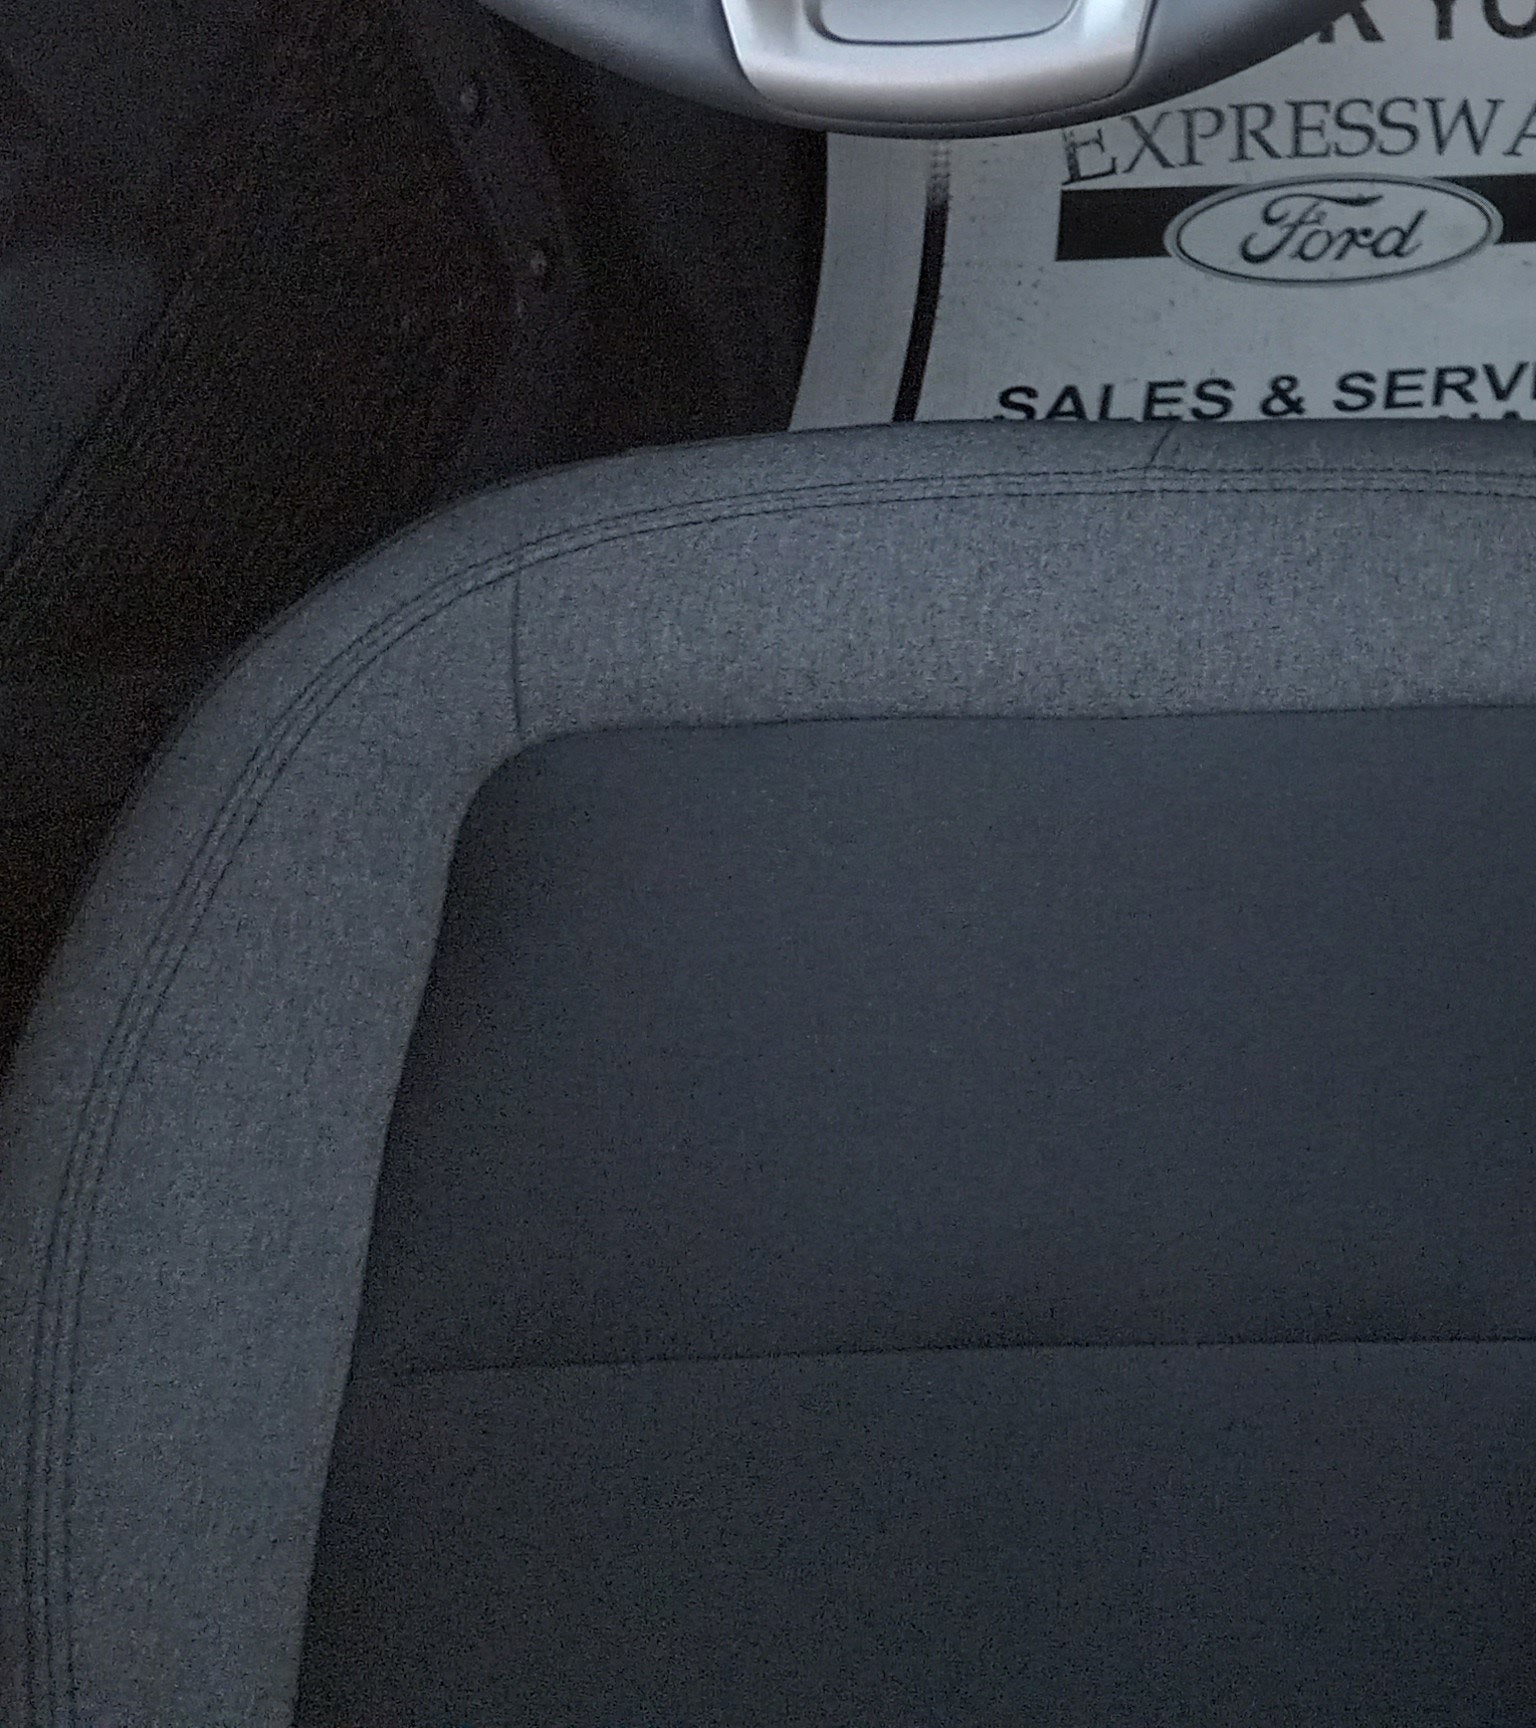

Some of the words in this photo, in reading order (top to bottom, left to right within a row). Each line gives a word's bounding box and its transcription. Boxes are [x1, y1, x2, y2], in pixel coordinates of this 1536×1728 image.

[1240, 193, 1428, 267] Ford
[995, 376, 1233, 422] SALES
[1259, 375, 1307, 418] &
